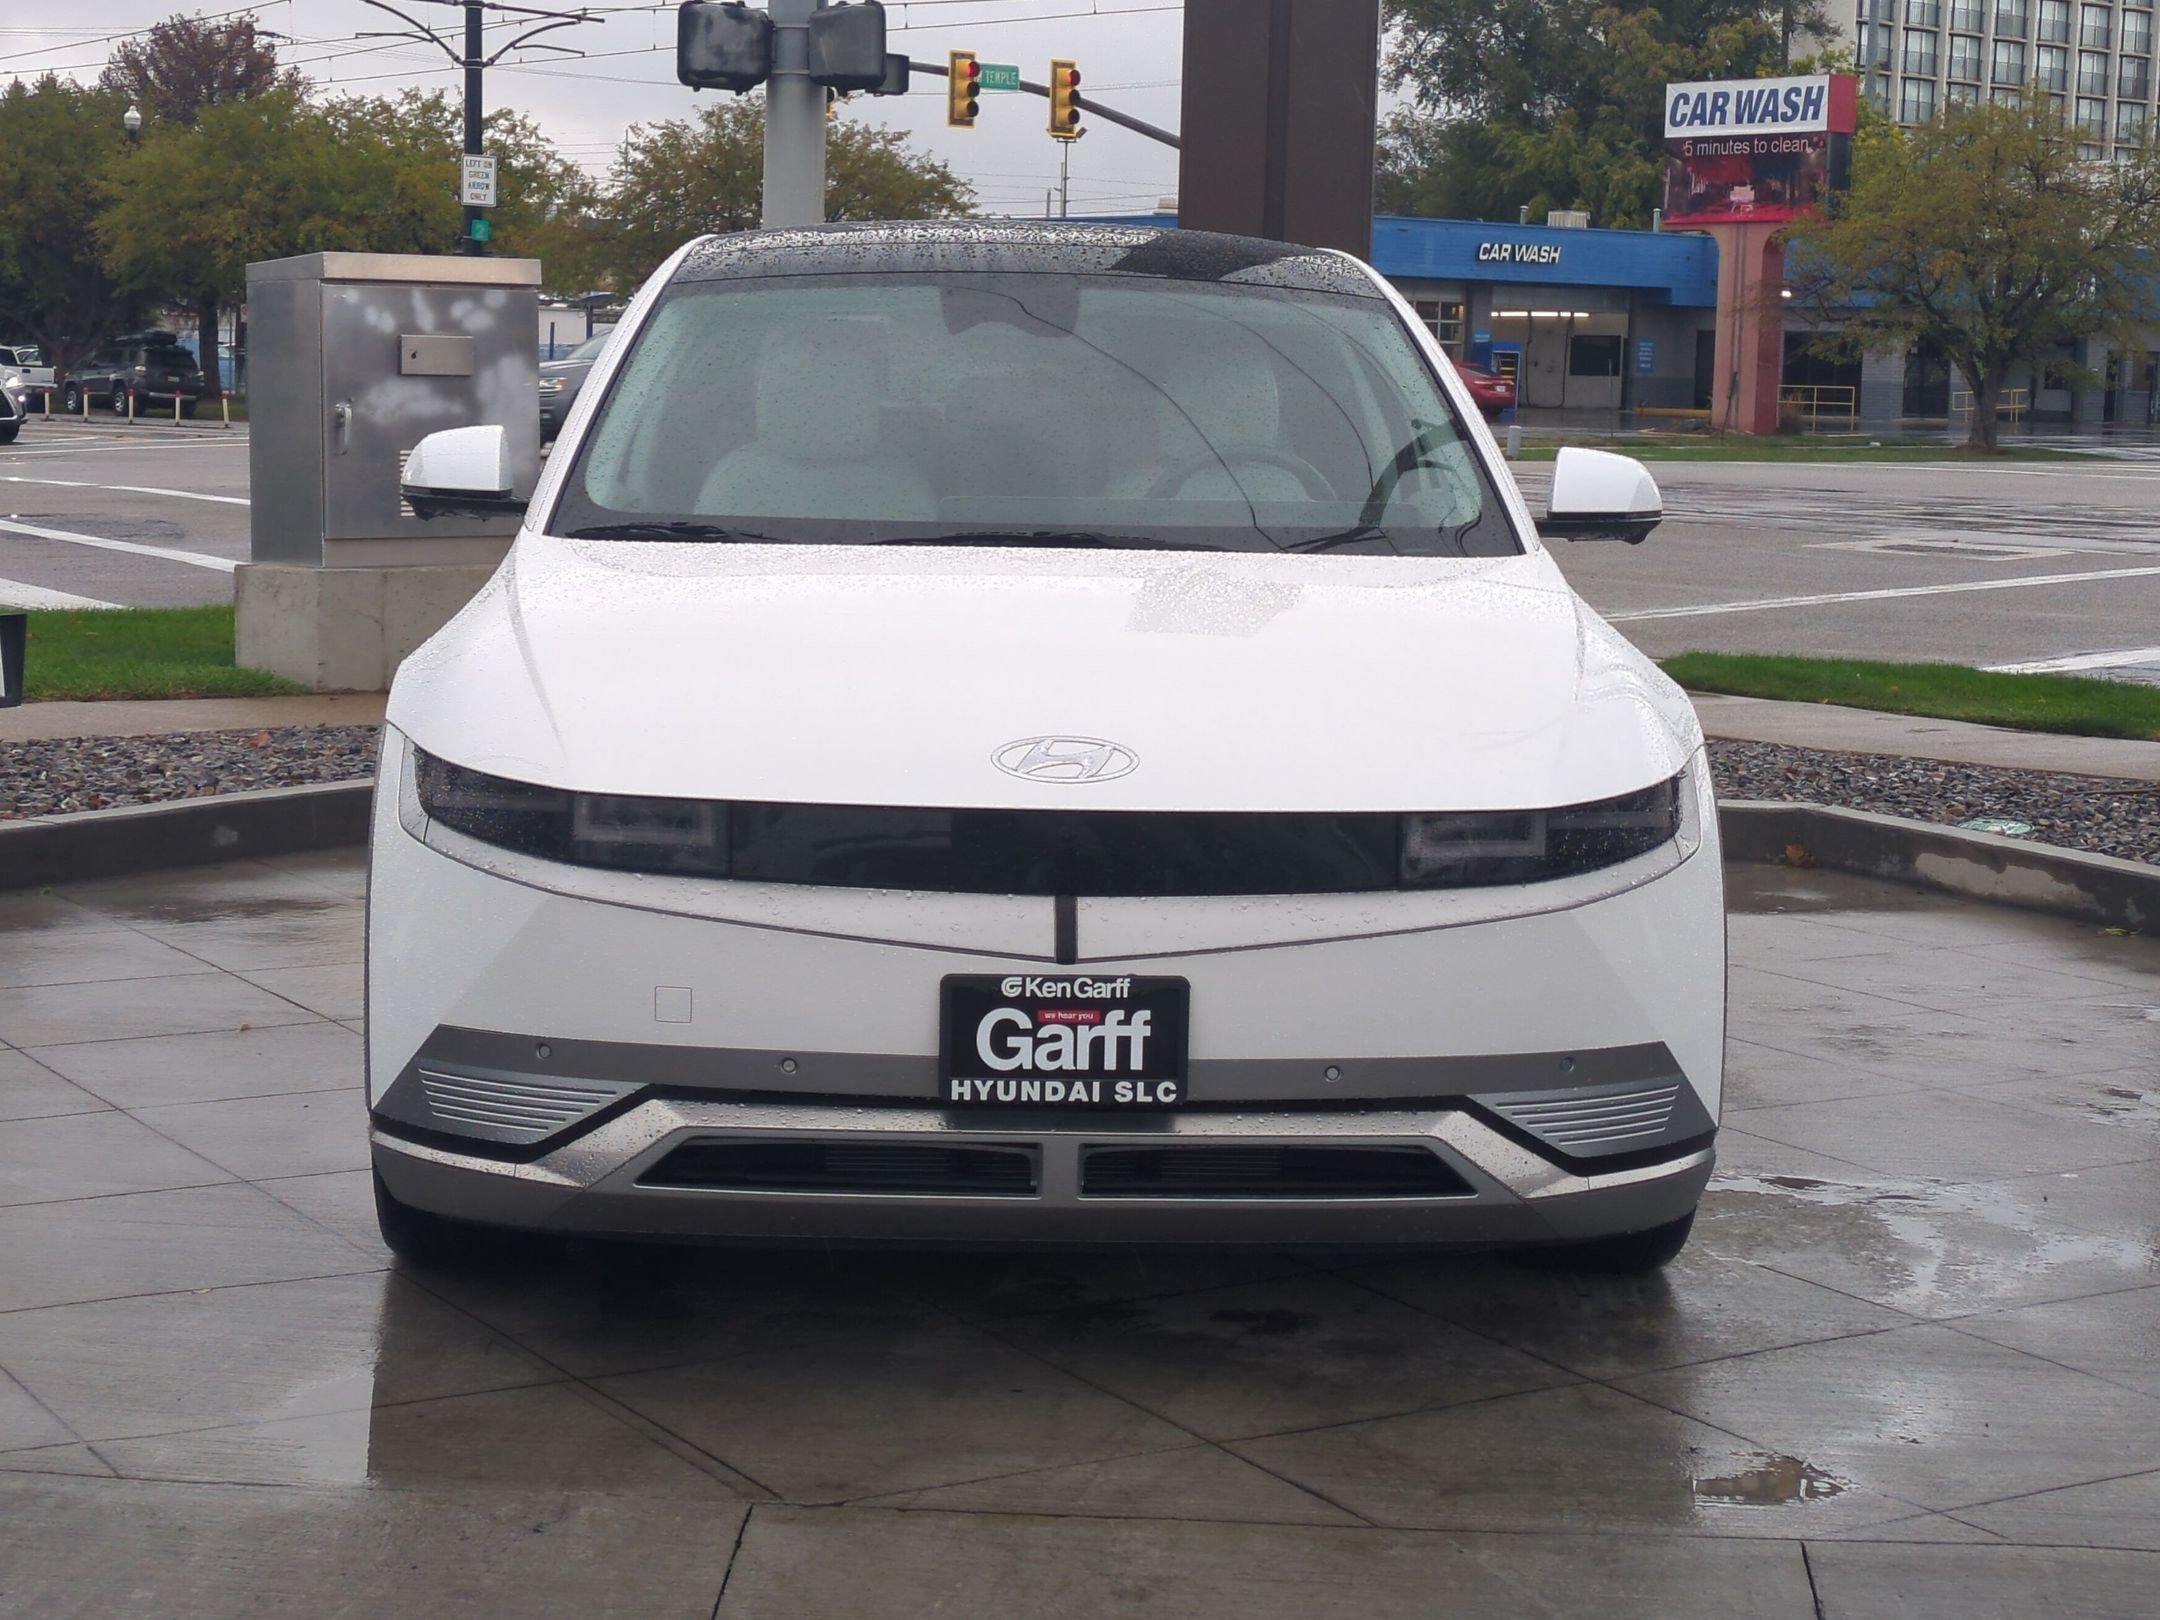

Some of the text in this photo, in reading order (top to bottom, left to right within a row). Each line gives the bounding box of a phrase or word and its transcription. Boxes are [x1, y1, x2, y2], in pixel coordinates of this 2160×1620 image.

[984, 70, 1017, 85] TEMPLE
[1669, 85, 1825, 128] CAR WASH
[1684, 136, 1810, 157] 5 minutes to clean
[465, 159, 493, 169] LEFT ON
[468, 170, 490, 179] GREEN
[467, 181, 490, 190] ARROW
[470, 192, 487, 201] ONLY
[1478, 242, 1562, 264] CAR WASH
[1057, 1010, 1078, 1020] hear
[1078, 1013, 1094, 1021] you
[976, 1007, 1151, 1071] Garff
[951, 1079, 1177, 1103] HYUNDAI SLC
